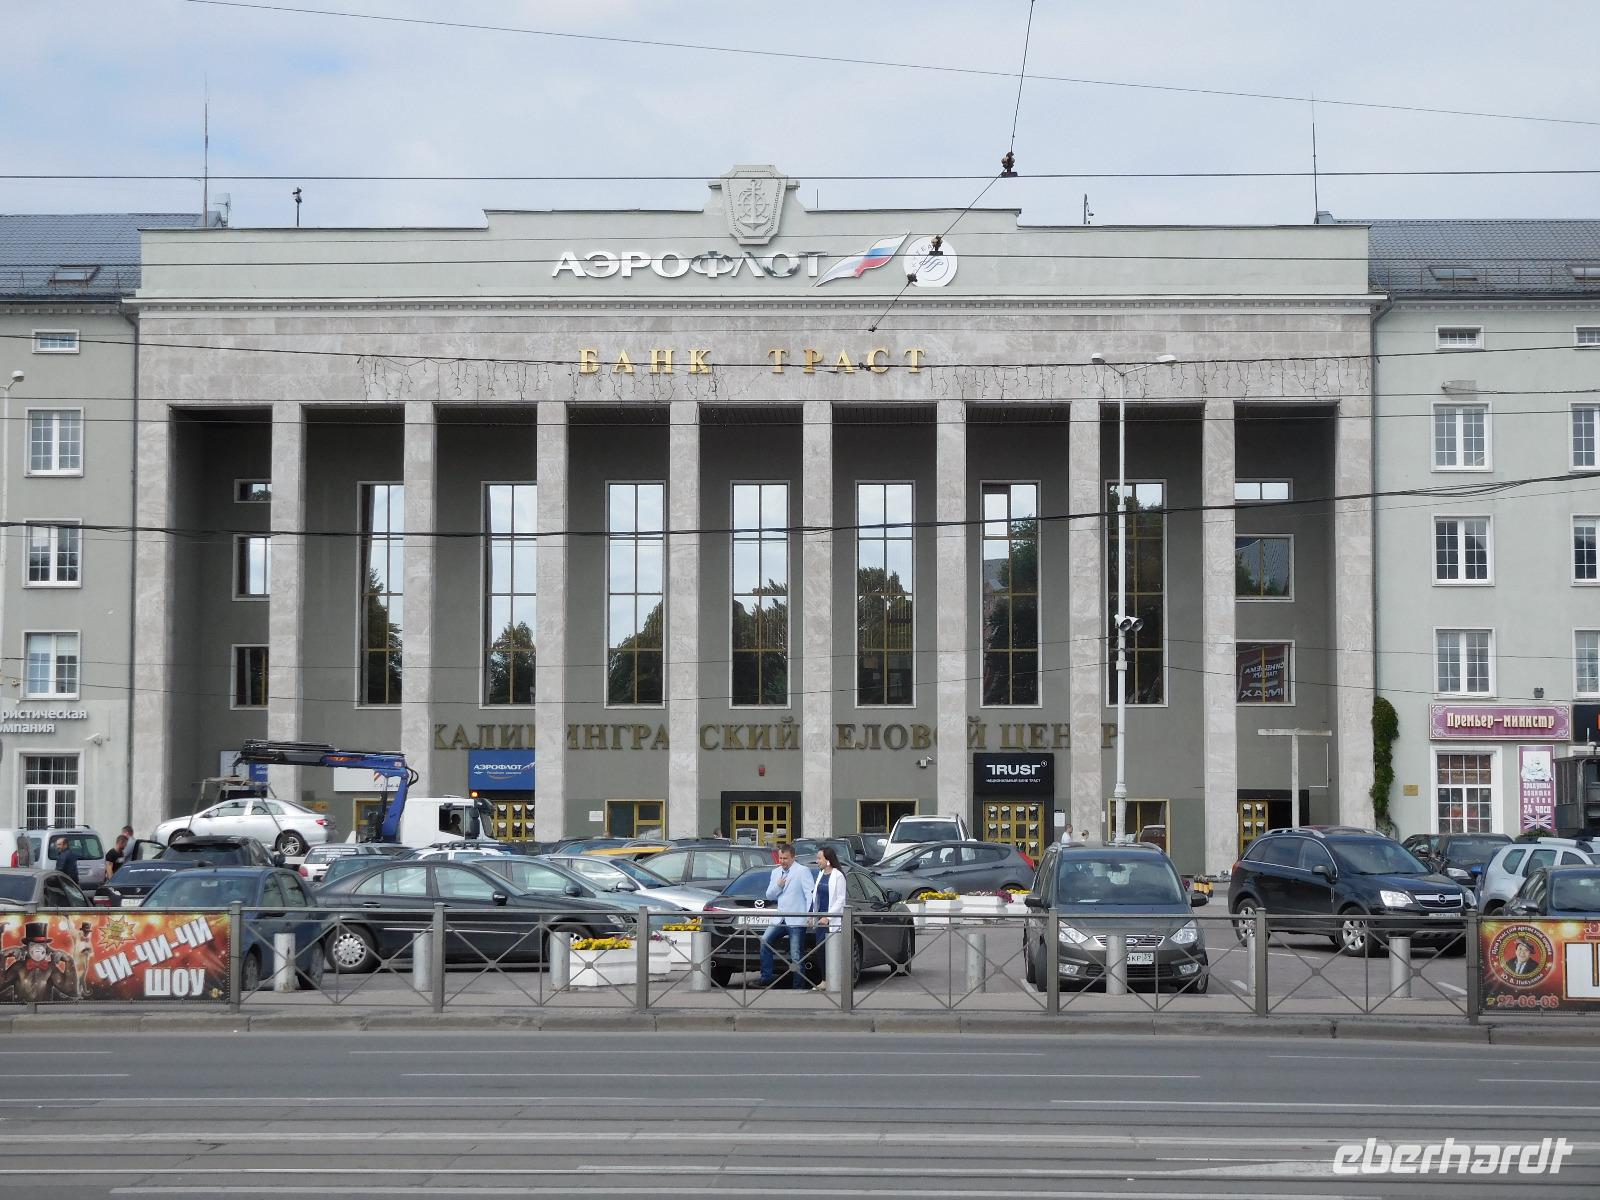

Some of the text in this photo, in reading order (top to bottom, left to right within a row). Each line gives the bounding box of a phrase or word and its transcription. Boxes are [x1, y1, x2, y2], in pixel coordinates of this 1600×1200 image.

[552, 250, 828, 279] АЭРОФЛОТ
[578, 348, 927, 375] БАНК ТРАСТ
[434, 716, 1118, 752] КАЛИИНГРАСКИЙ ЕЛОВЙ ЦЕНР
[1446, 712, 1555, 729] Премьер-министр
[986, 764, 1041, 775] TRUST
[95, 915, 215, 986] ЧИ-ЧИ-ЧИ
[144, 967, 205, 997] ШОУ
